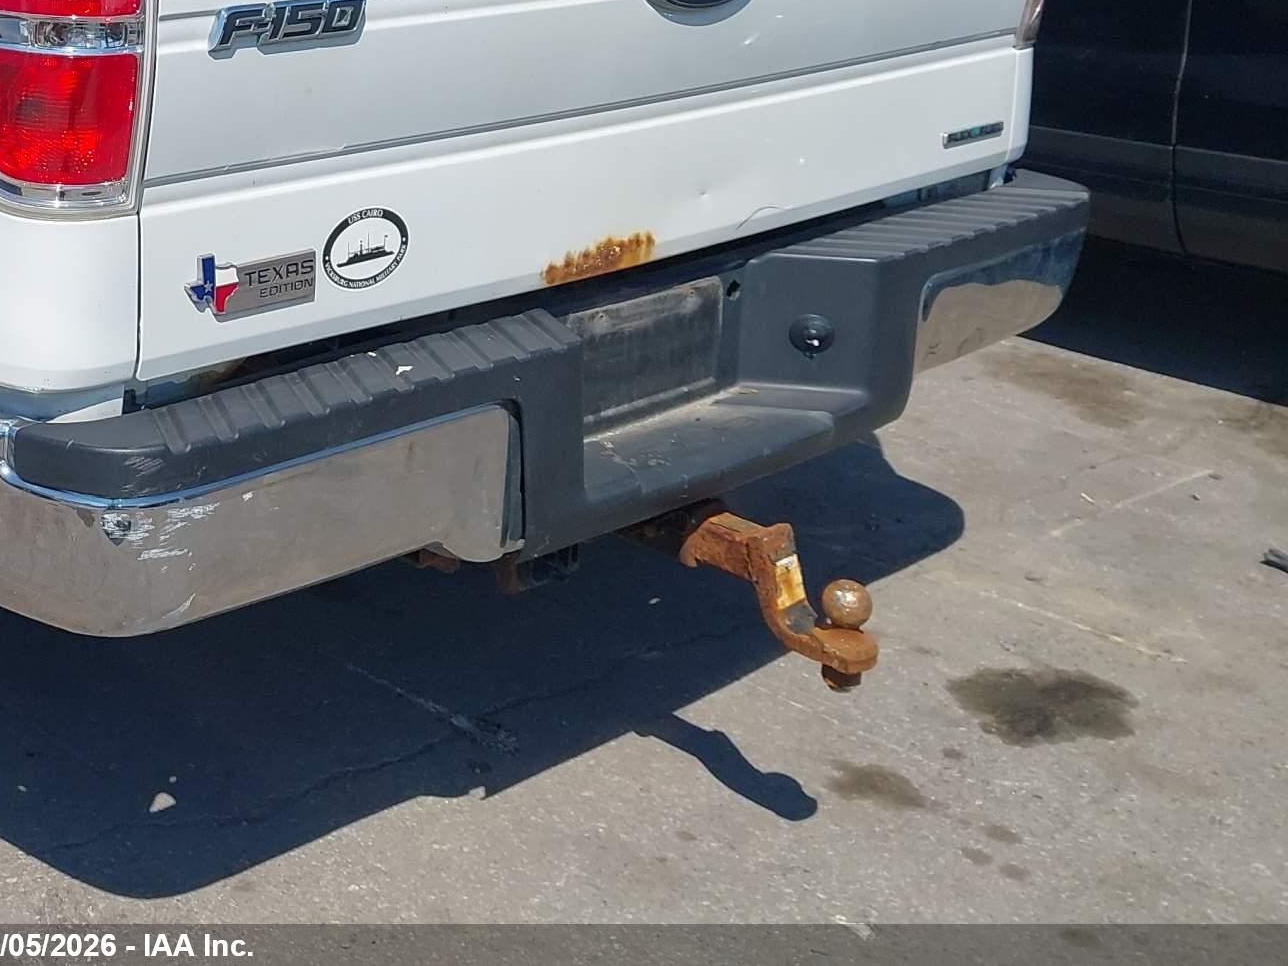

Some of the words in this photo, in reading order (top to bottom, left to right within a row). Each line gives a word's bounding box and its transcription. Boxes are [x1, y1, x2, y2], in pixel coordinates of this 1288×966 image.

[244, 259, 314, 286] TEXAS
[349, 277, 375, 288] NATIONAL
[259, 278, 313, 298] EDITION
